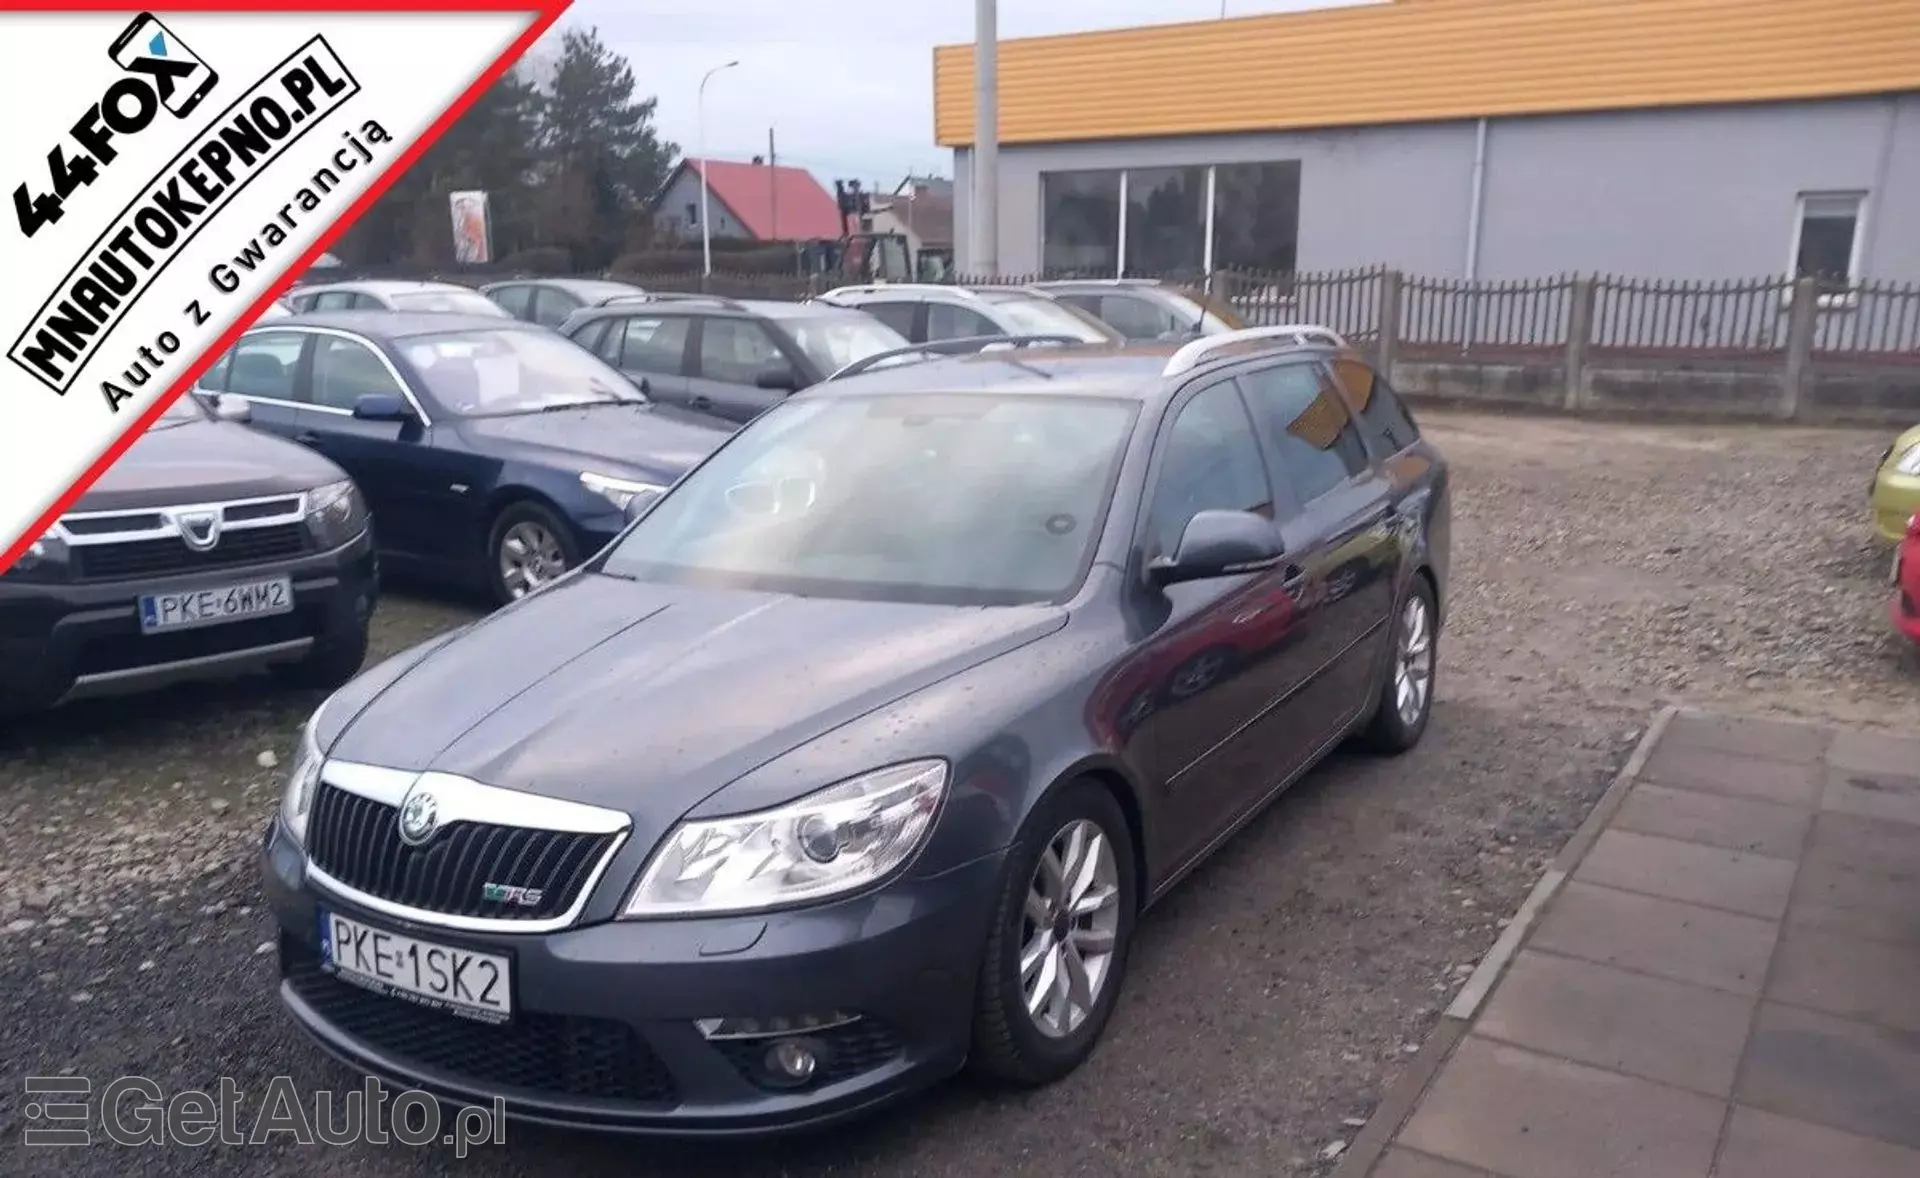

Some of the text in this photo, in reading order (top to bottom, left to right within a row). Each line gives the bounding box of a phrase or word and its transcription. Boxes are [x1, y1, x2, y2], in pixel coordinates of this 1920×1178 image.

[162, 591, 214, 622] PKE
[334, 918, 394, 978] PKE
[408, 943, 500, 1005] 1SK2
